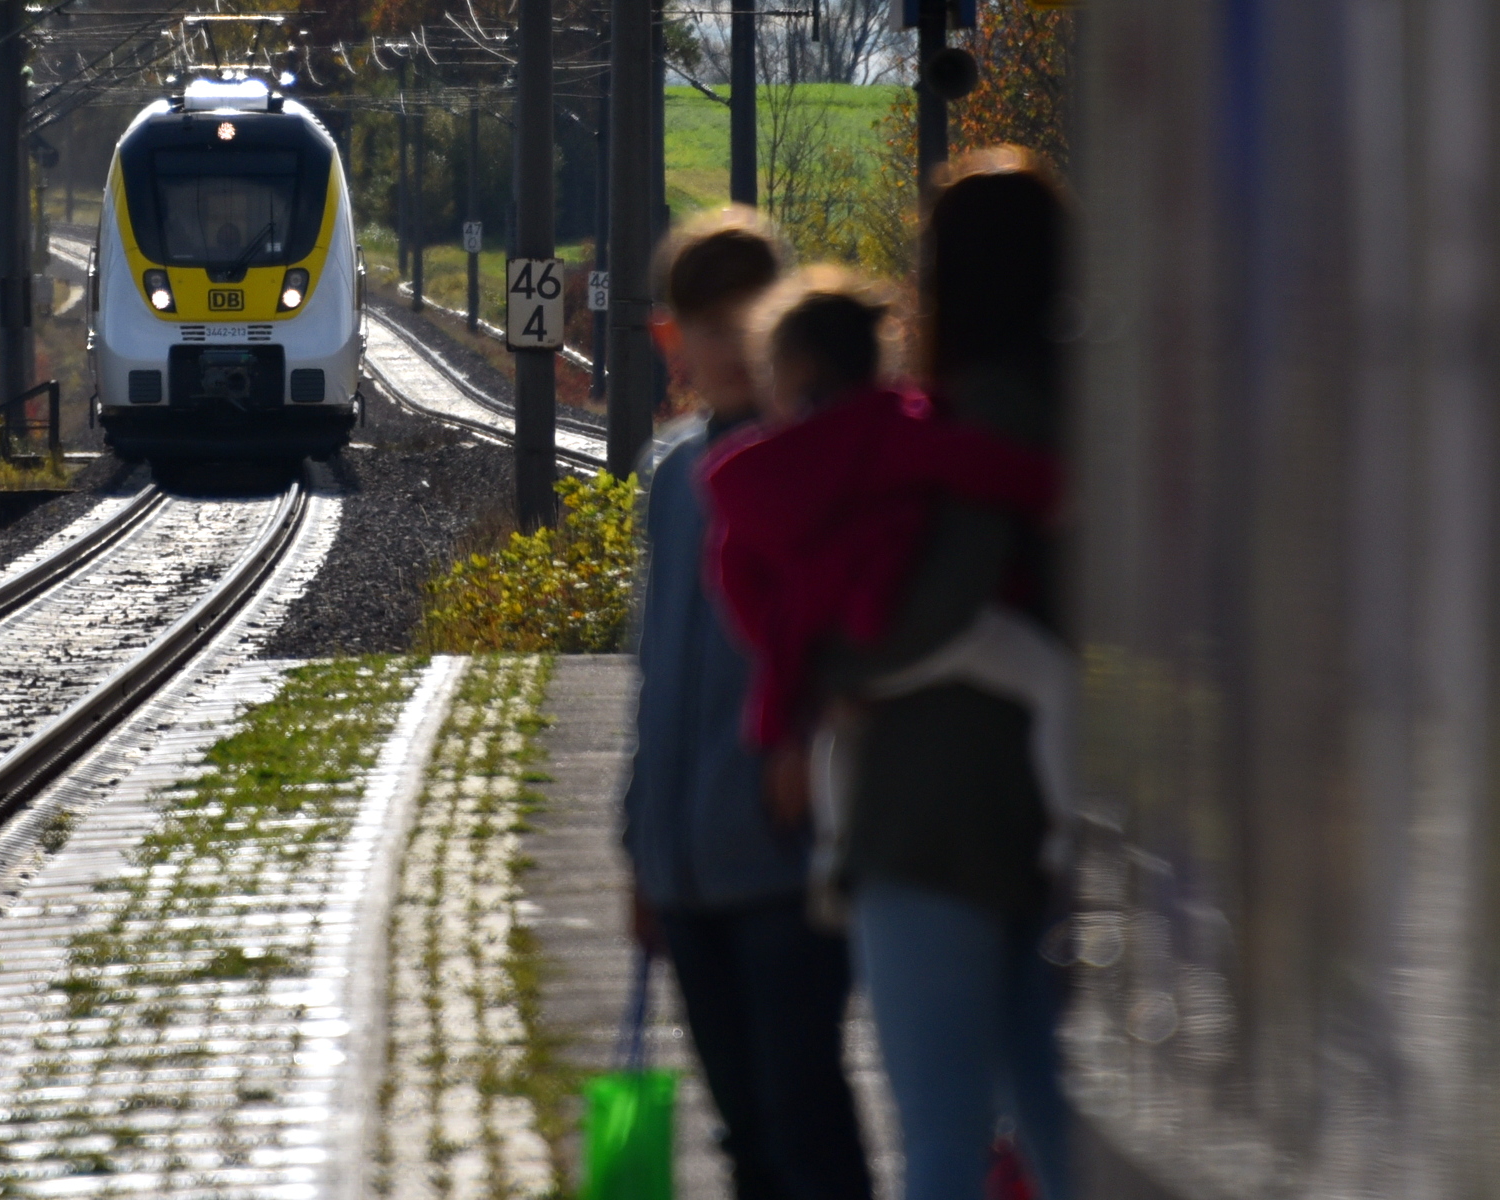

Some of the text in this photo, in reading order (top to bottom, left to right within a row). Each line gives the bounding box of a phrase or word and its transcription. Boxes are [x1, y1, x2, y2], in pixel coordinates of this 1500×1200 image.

[465, 224, 481, 235] 47
[510, 263, 561, 299] 46
[590, 273, 610, 289] 46
[211, 291, 241, 309] DB
[595, 291, 605, 306] 8
[522, 305, 547, 341] 4
[206, 327, 246, 336] 3442-213
